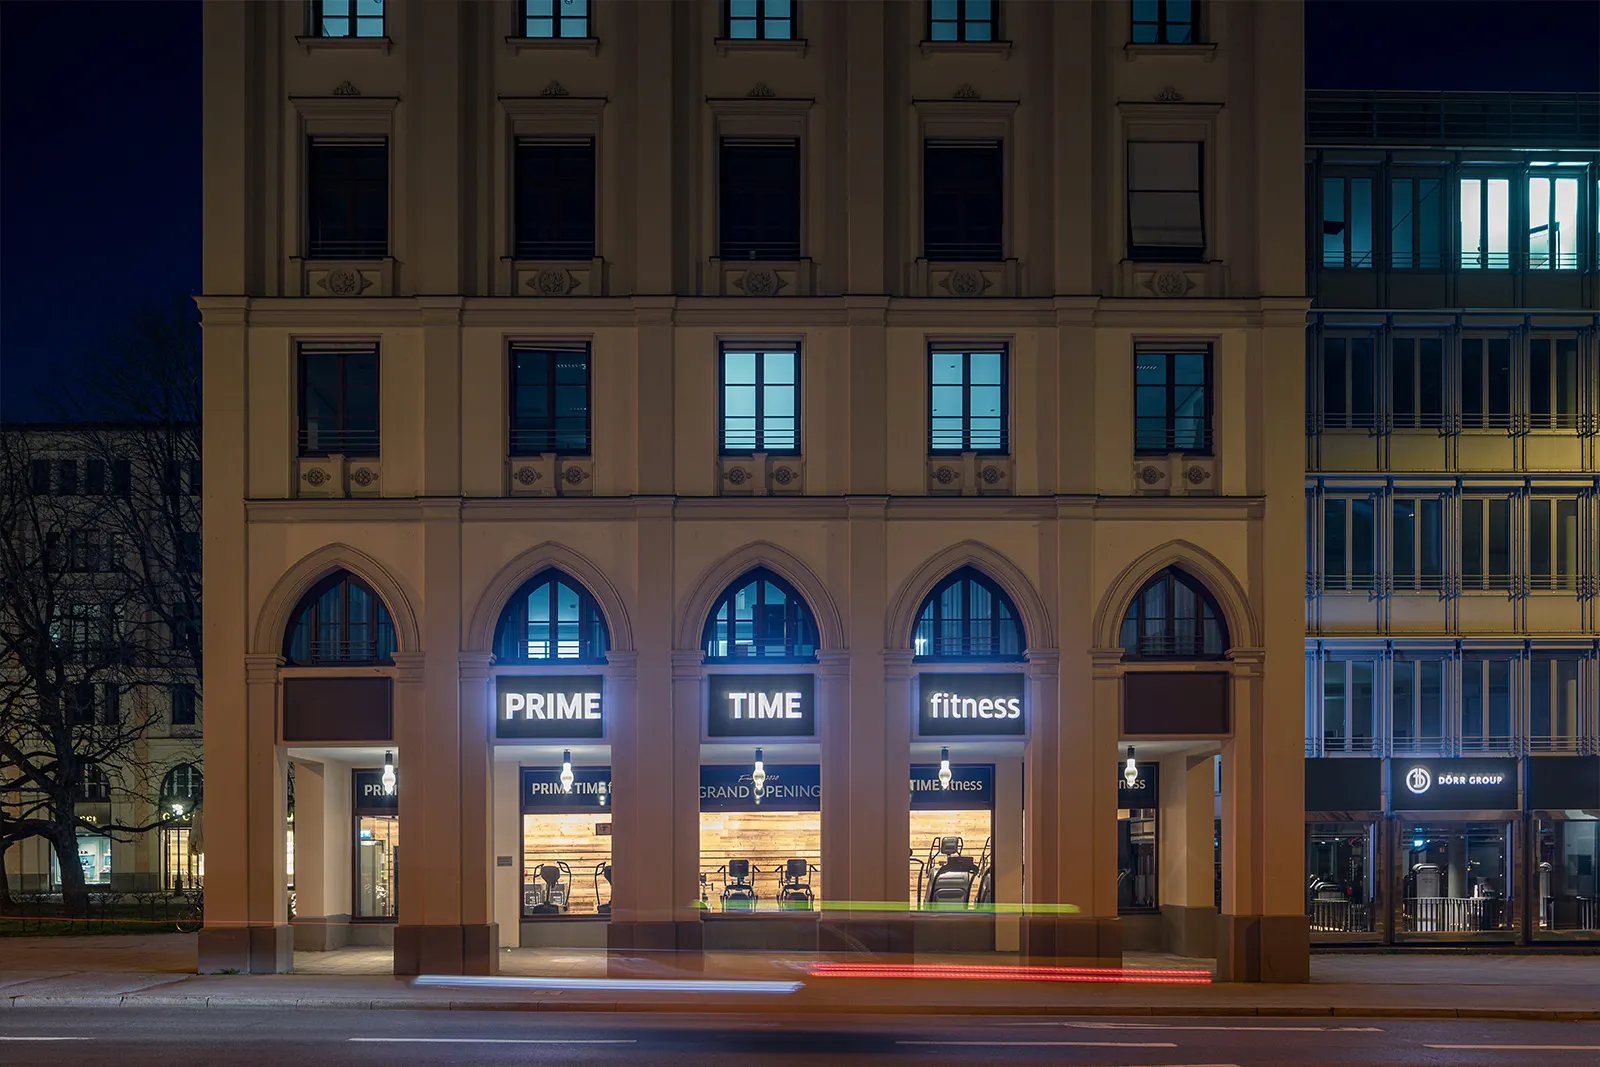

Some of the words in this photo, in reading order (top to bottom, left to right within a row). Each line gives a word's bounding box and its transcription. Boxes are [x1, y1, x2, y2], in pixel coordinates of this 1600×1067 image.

[505, 692, 602, 720] PRIME
[728, 692, 803, 719] TIME
[930, 692, 1021, 719] fitness
[909, 779, 940, 791] TIME
[941, 779, 983, 791] tness
[1438, 774, 1466, 785] DÖRR
[1468, 776, 1503, 785] GROUP
[574, 782, 606, 794] TIME
[699, 785, 750, 799] GRAND
[753, 784, 820, 798] OPENING
